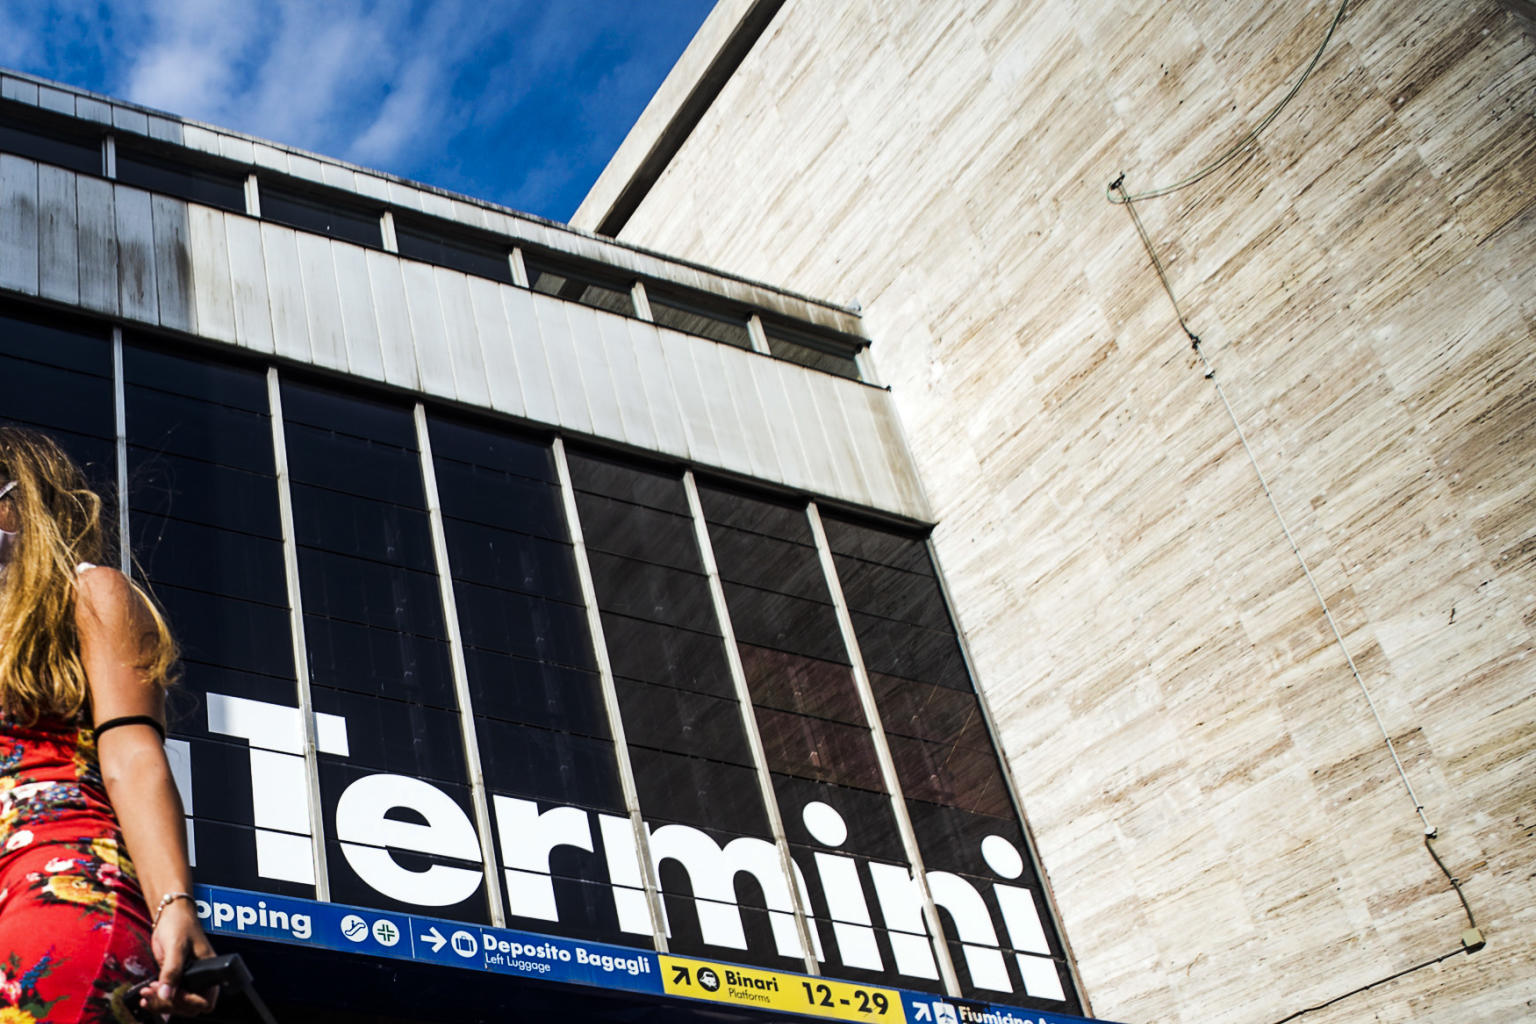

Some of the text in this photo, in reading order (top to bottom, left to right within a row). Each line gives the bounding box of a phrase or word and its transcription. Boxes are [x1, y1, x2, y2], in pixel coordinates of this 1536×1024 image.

[206, 692, 1066, 1001] Termini
[195, 900, 312, 940] opping
[482, 934, 651, 975] Deposito Bagagli
[484, 952, 551, 974] Left Luggage
[725, 970, 779, 992] Binari
[728, 988, 771, 1003] Platforms
